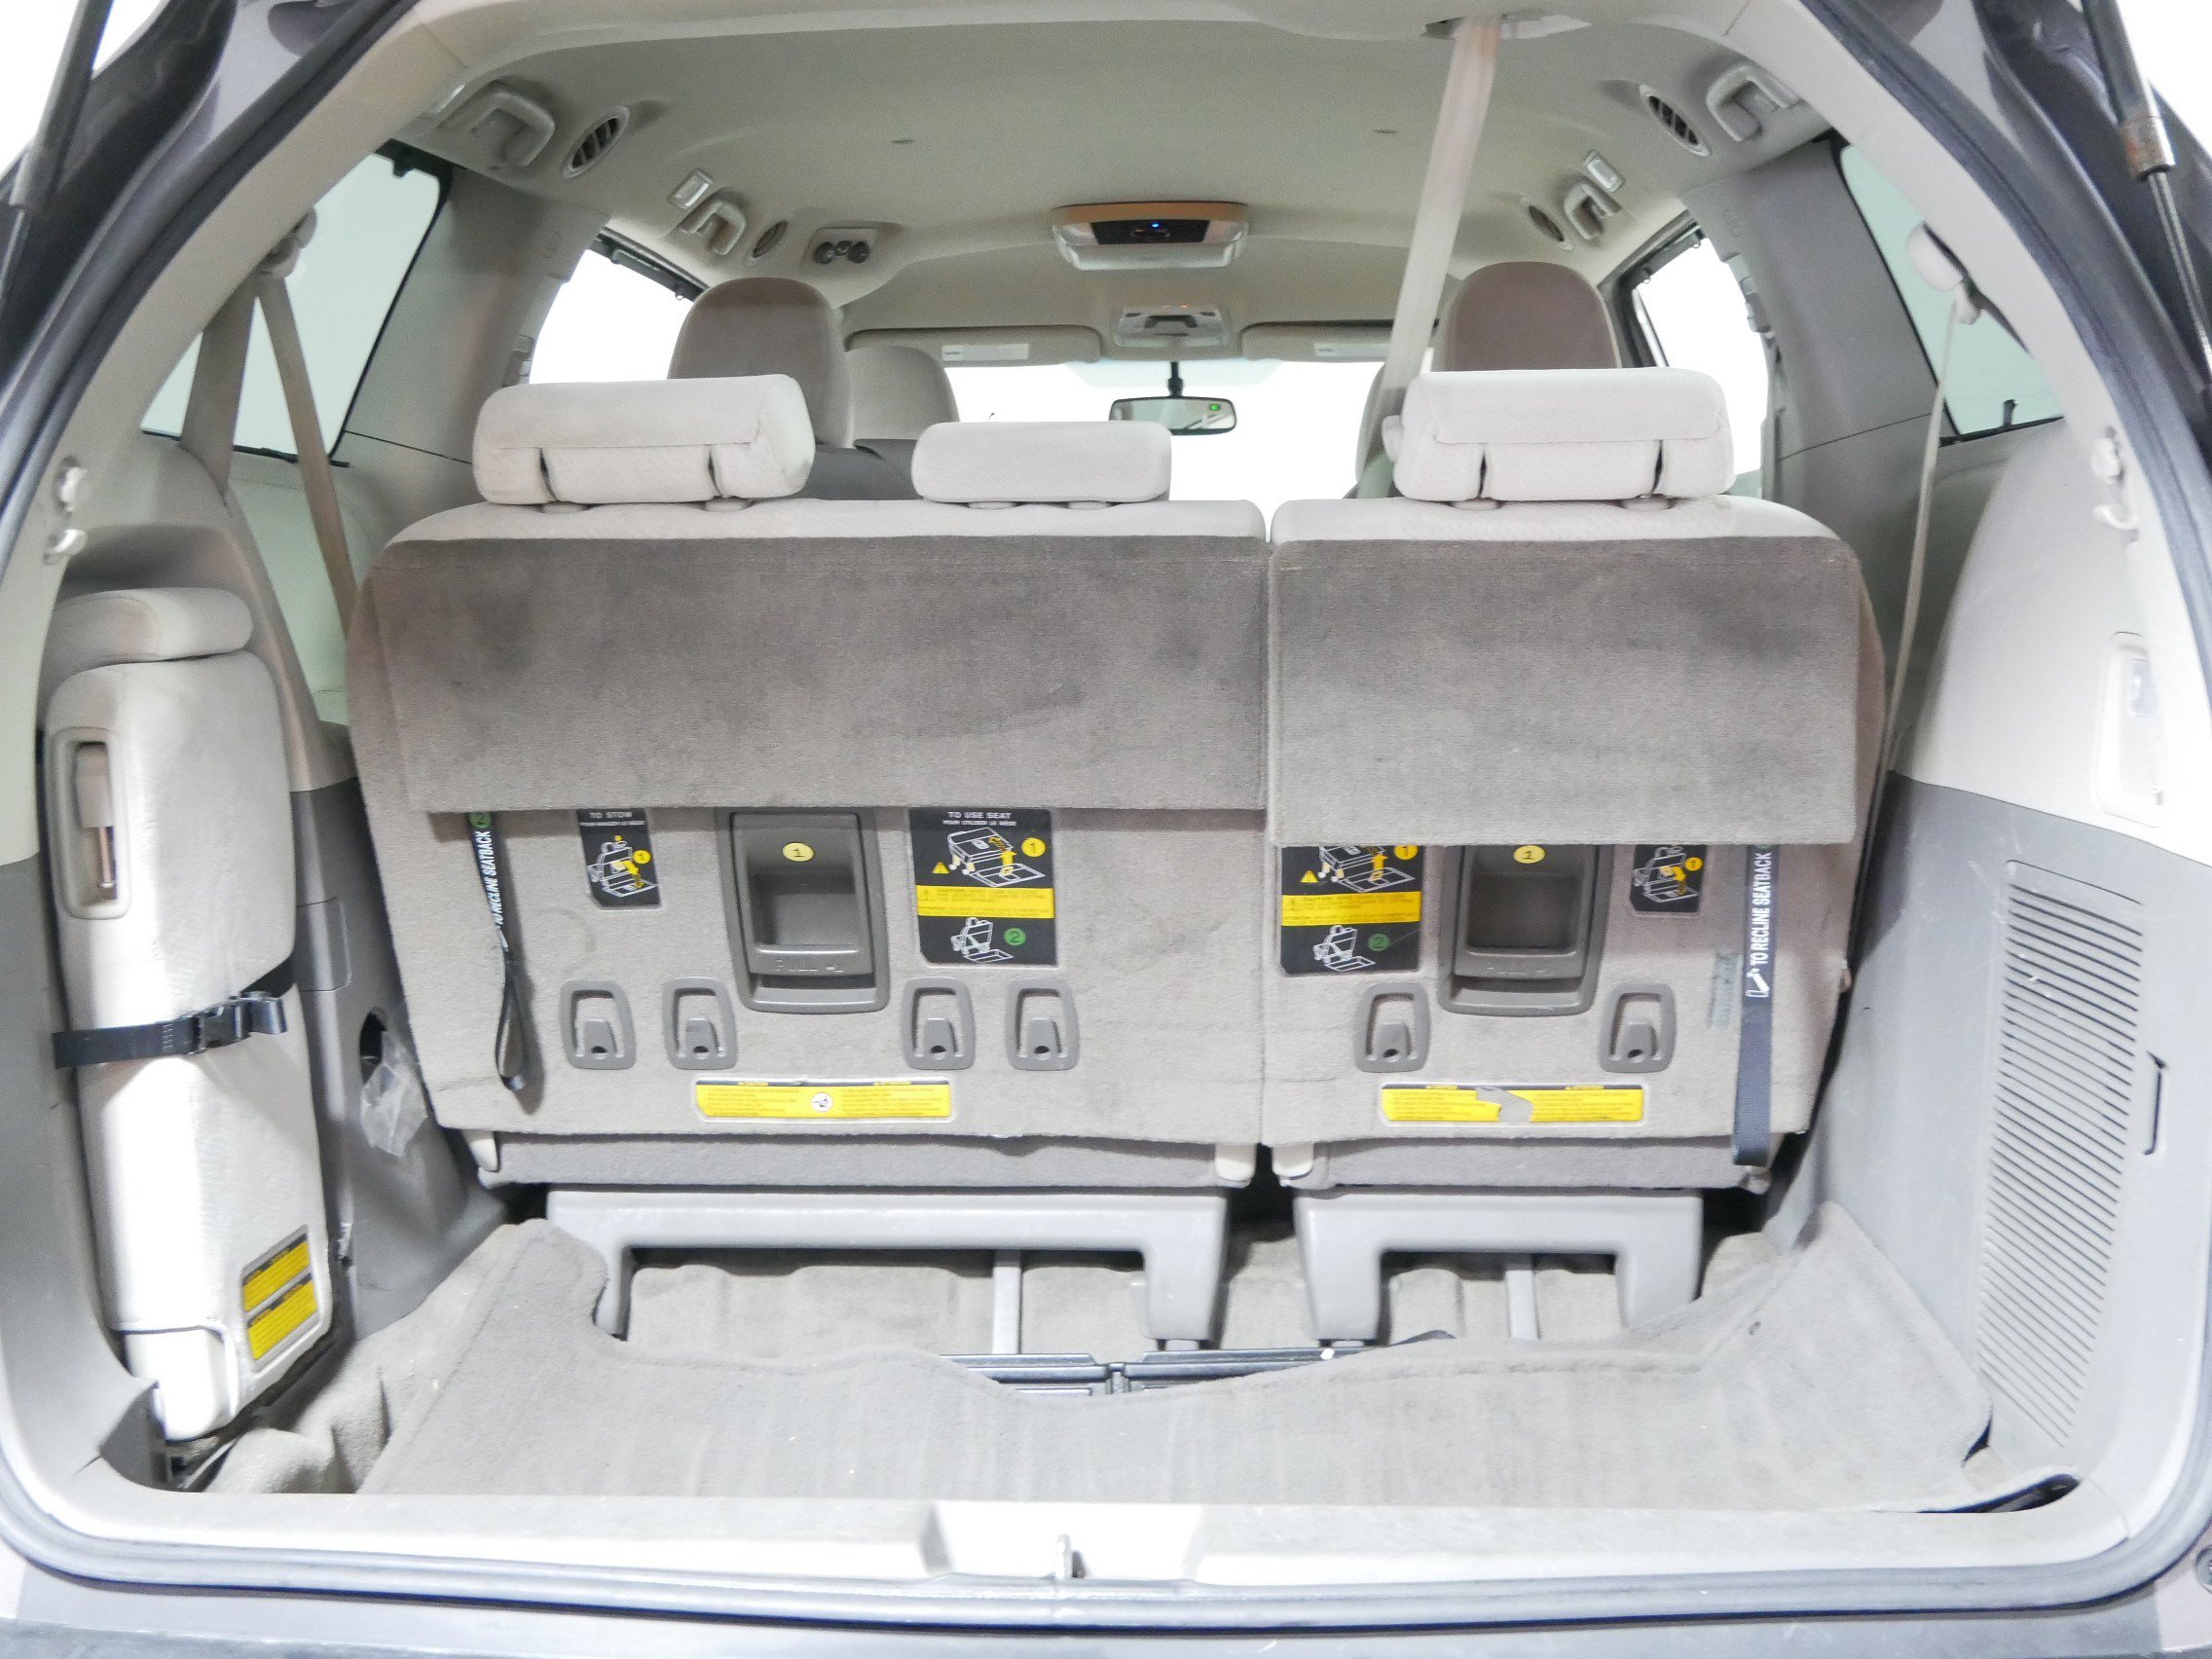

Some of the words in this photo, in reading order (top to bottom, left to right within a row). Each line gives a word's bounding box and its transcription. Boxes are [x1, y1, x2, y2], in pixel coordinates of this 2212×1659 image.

[474, 830, 498, 876] SEATBACK
[1751, 852, 1773, 905] SEATBACK
[1750, 907, 1771, 951] RECLINE
[1750, 952, 1769, 966] TO
